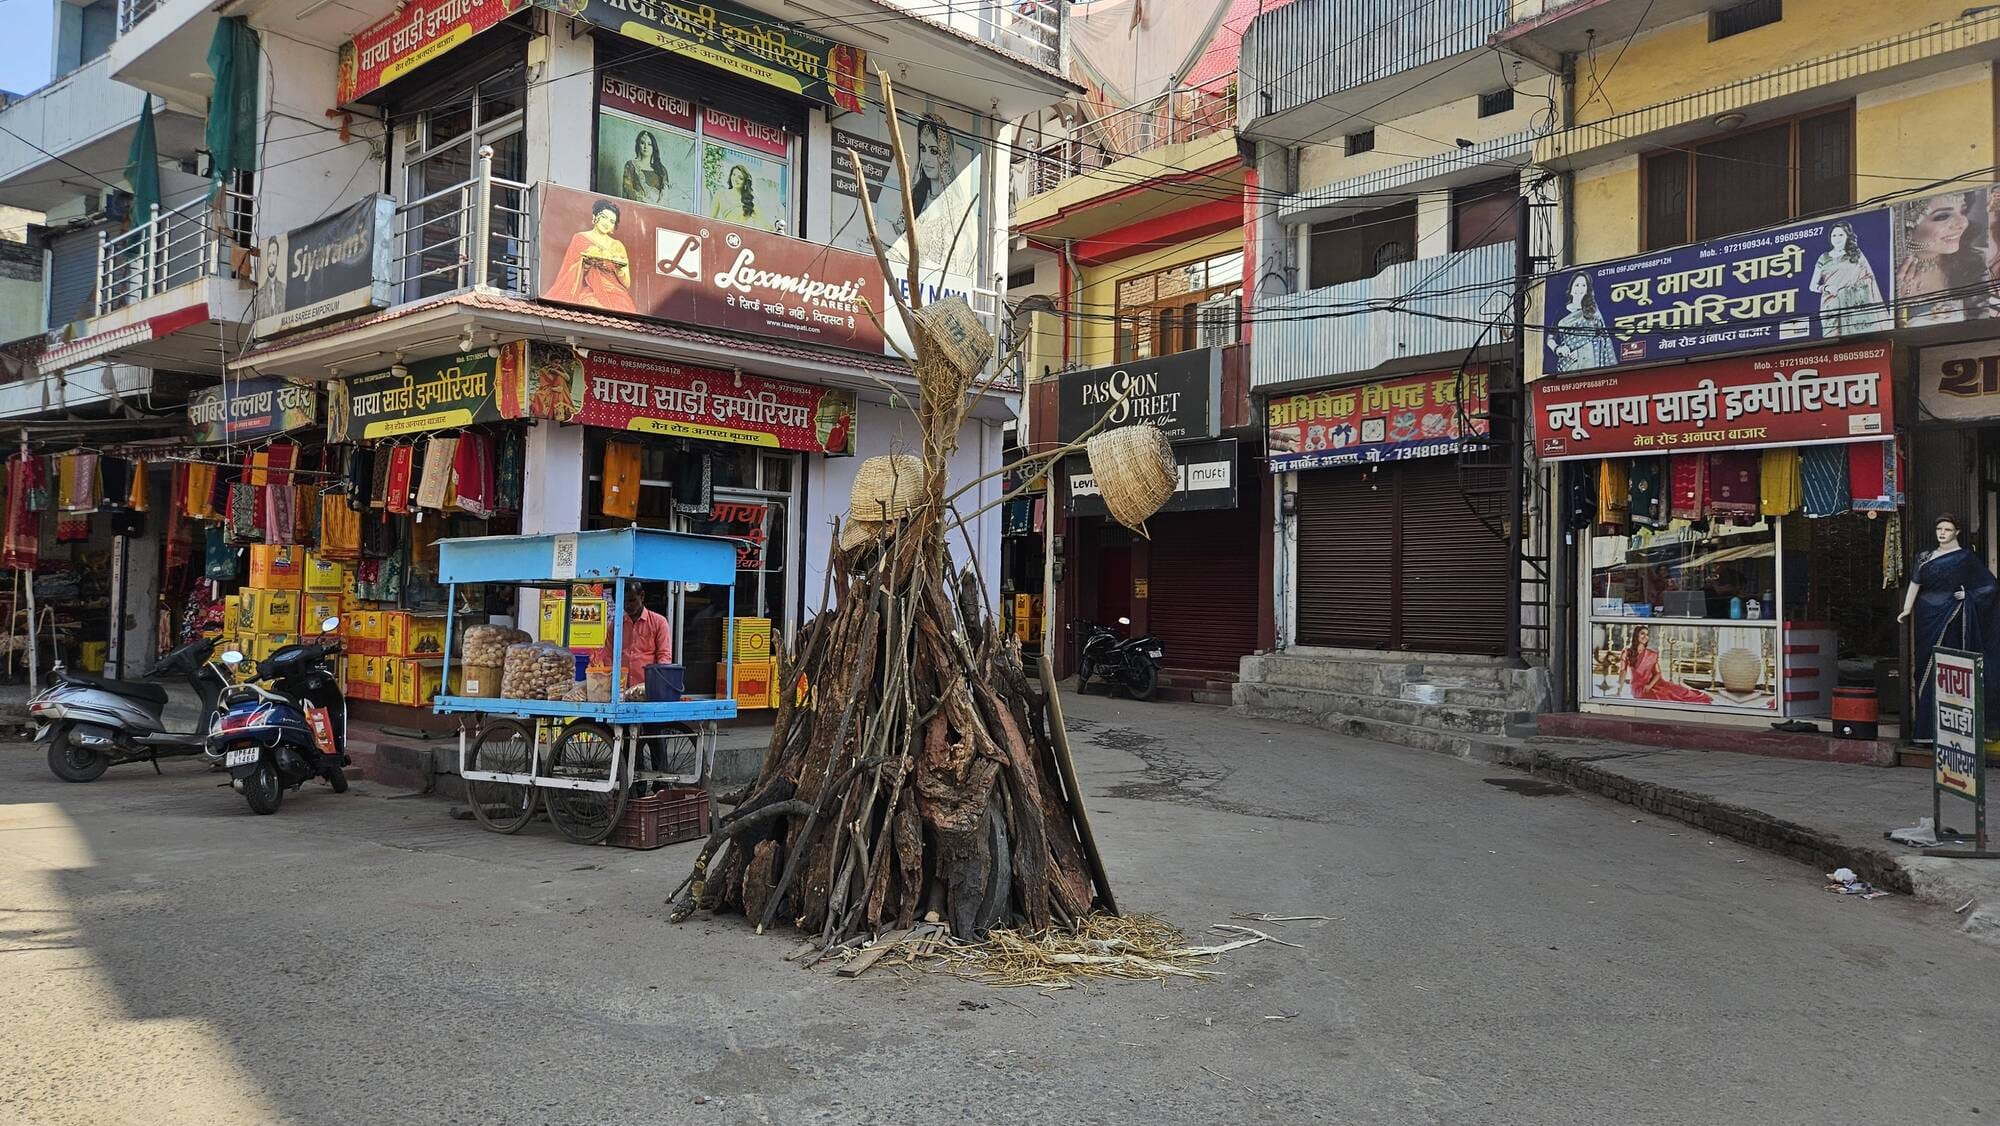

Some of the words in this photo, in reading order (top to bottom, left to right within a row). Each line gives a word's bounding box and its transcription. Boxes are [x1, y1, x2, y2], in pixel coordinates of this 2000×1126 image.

[361, 37, 391, 71] माया
[392, 7, 425, 50] साड़ी
[656, 33, 674, 46] मेन
[700, 49, 738, 68] अनपरा
[1699, 248, 1718, 258] Mob.
[1723, 238, 1773, 255] 9721909344,
[1774, 226, 1824, 245] 8960598527
[714, 248, 860, 303] Laxmipati
[1597, 267, 1615, 277] GSTIN
[1610, 277, 1652, 307] न्यू
[1657, 263, 1726, 295] माया
[1732, 243, 1806, 284] साड़ी
[281, 315, 295, 327] MAYA
[295, 309, 312, 322] SAREE
[312, 299, 340, 318] EMPORIUM
[726, 293, 736, 307] ये
[847, 315, 855, 329] है
[812, 297, 860, 314] SAREES
[1614, 288, 1799, 341] इम्पोरियम
[766, 318, 821, 334] www.laxmipati.com
[1658, 337, 1677, 350] मेन
[1678, 333, 1697, 348] रोड
[1699, 330, 1736, 345] अनपरा
[1738, 325, 1772, 339] बाजार
[593, 355, 606, 364] GST
[1754, 361, 1773, 371] Mob.
[1779, 355, 1832, 369] 9721909344,
[1833, 349, 1885, 363] 8960598527
[353, 391, 381, 416] माया
[383, 375, 414, 416] साड़ी
[415, 367, 488, 410] इम्पोरियम
[592, 376, 649, 407] माया
[653, 380, 708, 420] साड़ी
[711, 389, 810, 429] इम्पोरियम
[1361, 382, 1427, 414] गिफ्ट
[1542, 384, 1561, 394] GSTIN
[1546, 402, 1591, 440] न्यू
[1585, 395, 1650, 430] माया
[1653, 379, 1718, 429] साड़ी
[1722, 368, 1881, 422] इम्पोरियम
[651, 420, 668, 432] मेन
[670, 423, 690, 435] रोड
[691, 426, 728, 439] अनपरा
[729, 431, 760, 443] बाजार
[1634, 432, 1654, 447] मेन
[1656, 430, 1679, 446] रोड
[1681, 428, 1726, 444] अनपरा
[1729, 426, 1767, 440] बाजार
[1269, 459, 1287, 473] मेन
[708, 502, 768, 524] माया
[1937, 662, 1973, 699] माया
[1940, 706, 1973, 735] साड़ी
